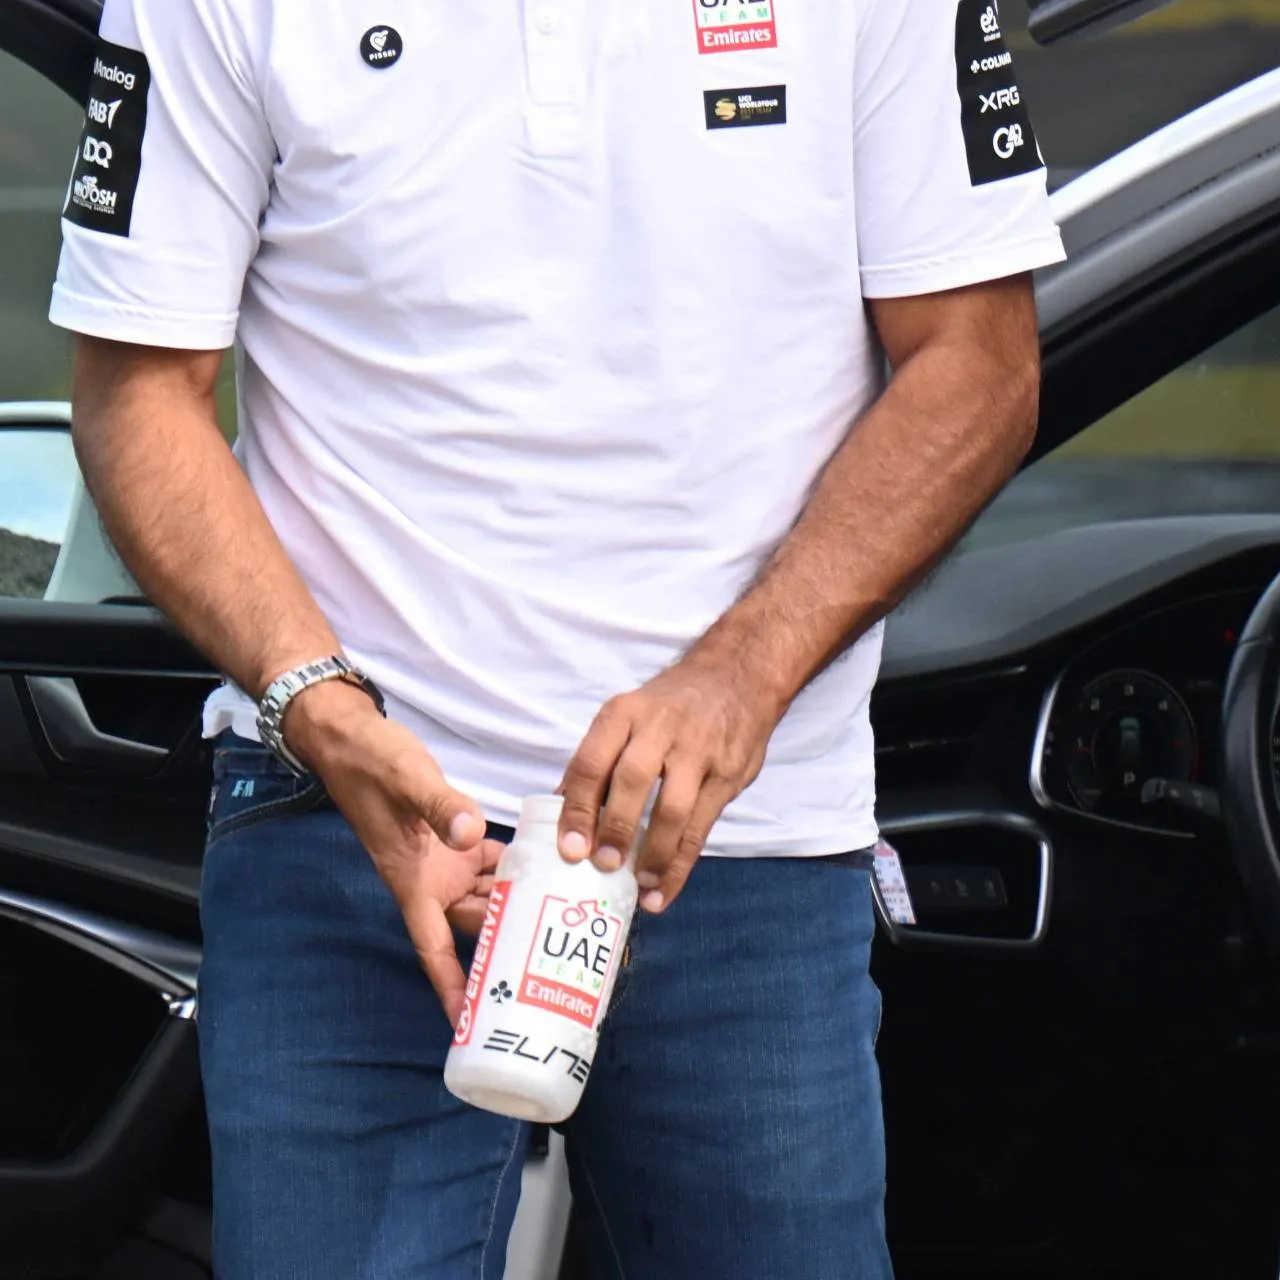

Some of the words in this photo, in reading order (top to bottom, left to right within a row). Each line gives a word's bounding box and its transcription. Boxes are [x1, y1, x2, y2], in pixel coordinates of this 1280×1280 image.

[702, 7, 768, 24] TEAM
[702, 28, 772, 47] Emirates
[979, 85, 1020, 114] XRG
[992, 123, 1024, 159] G42
[542, 926, 611, 976] UAE
[537, 958, 602, 991] TEAM
[525, 979, 594, 1018] Emirates
